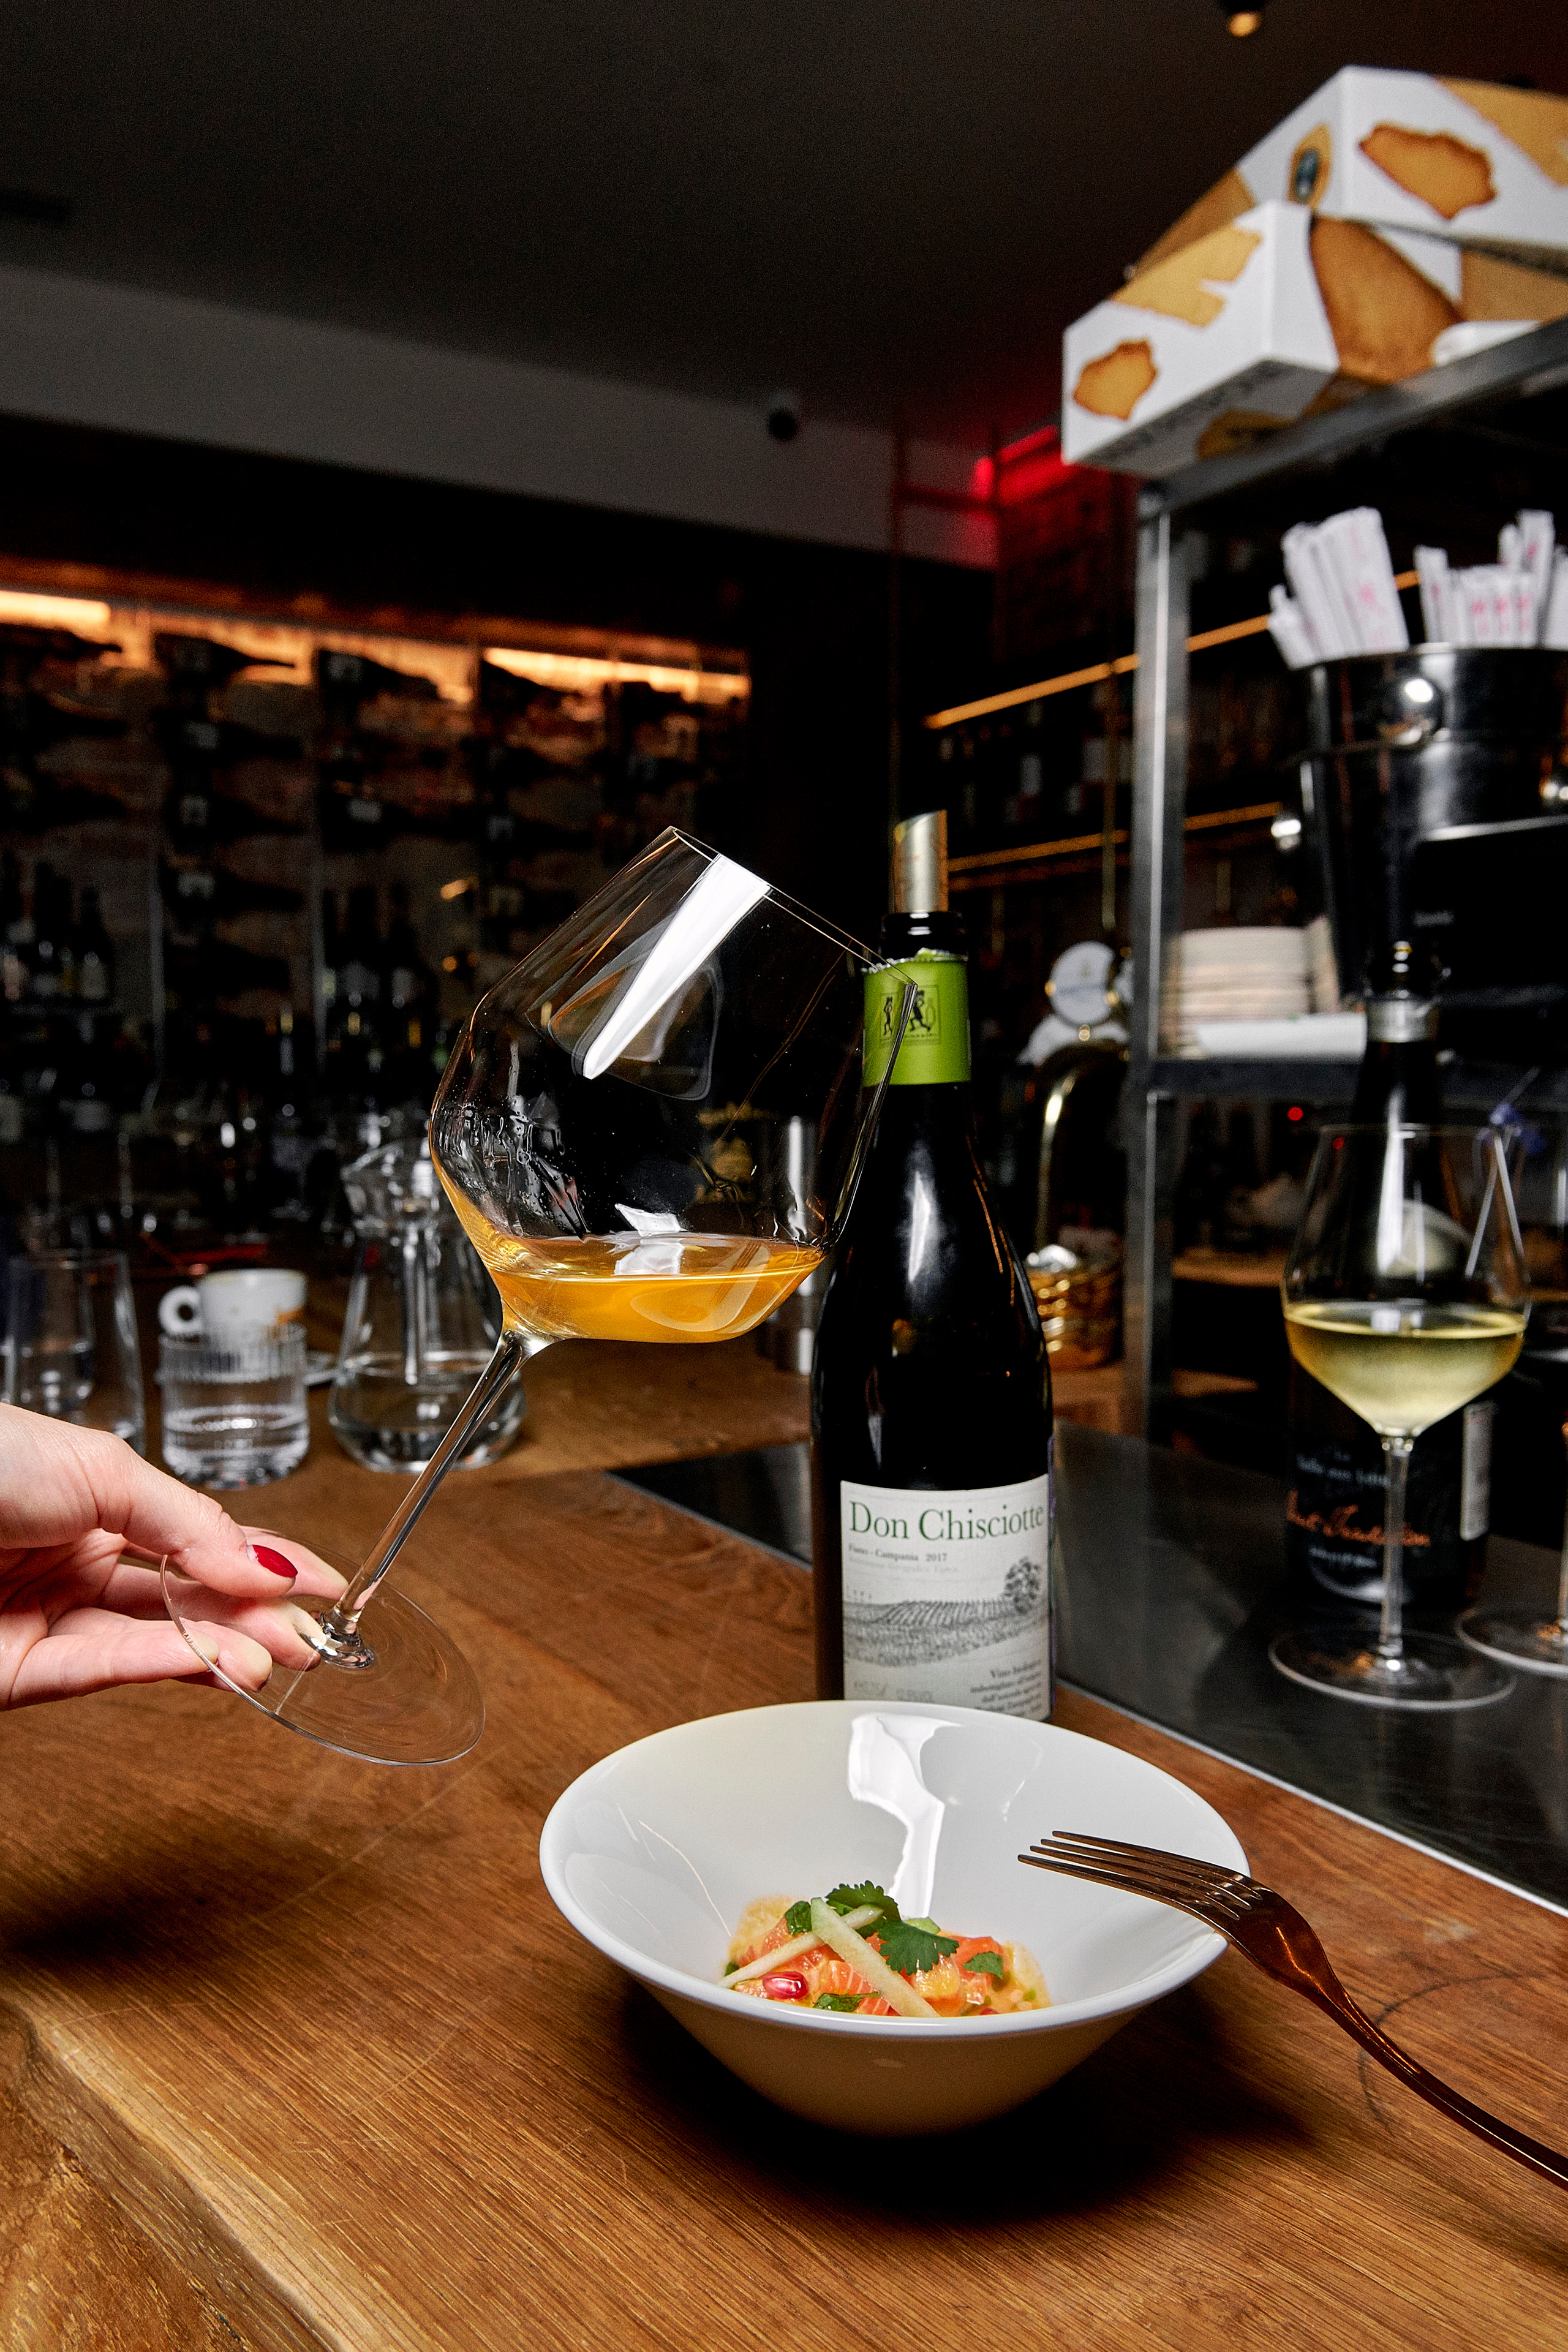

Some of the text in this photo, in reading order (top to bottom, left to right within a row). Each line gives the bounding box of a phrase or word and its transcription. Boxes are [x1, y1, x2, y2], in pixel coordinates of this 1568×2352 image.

[850, 1501, 1044, 1540] Don Chisciotte
[925, 1552, 948, 1562] 2017
